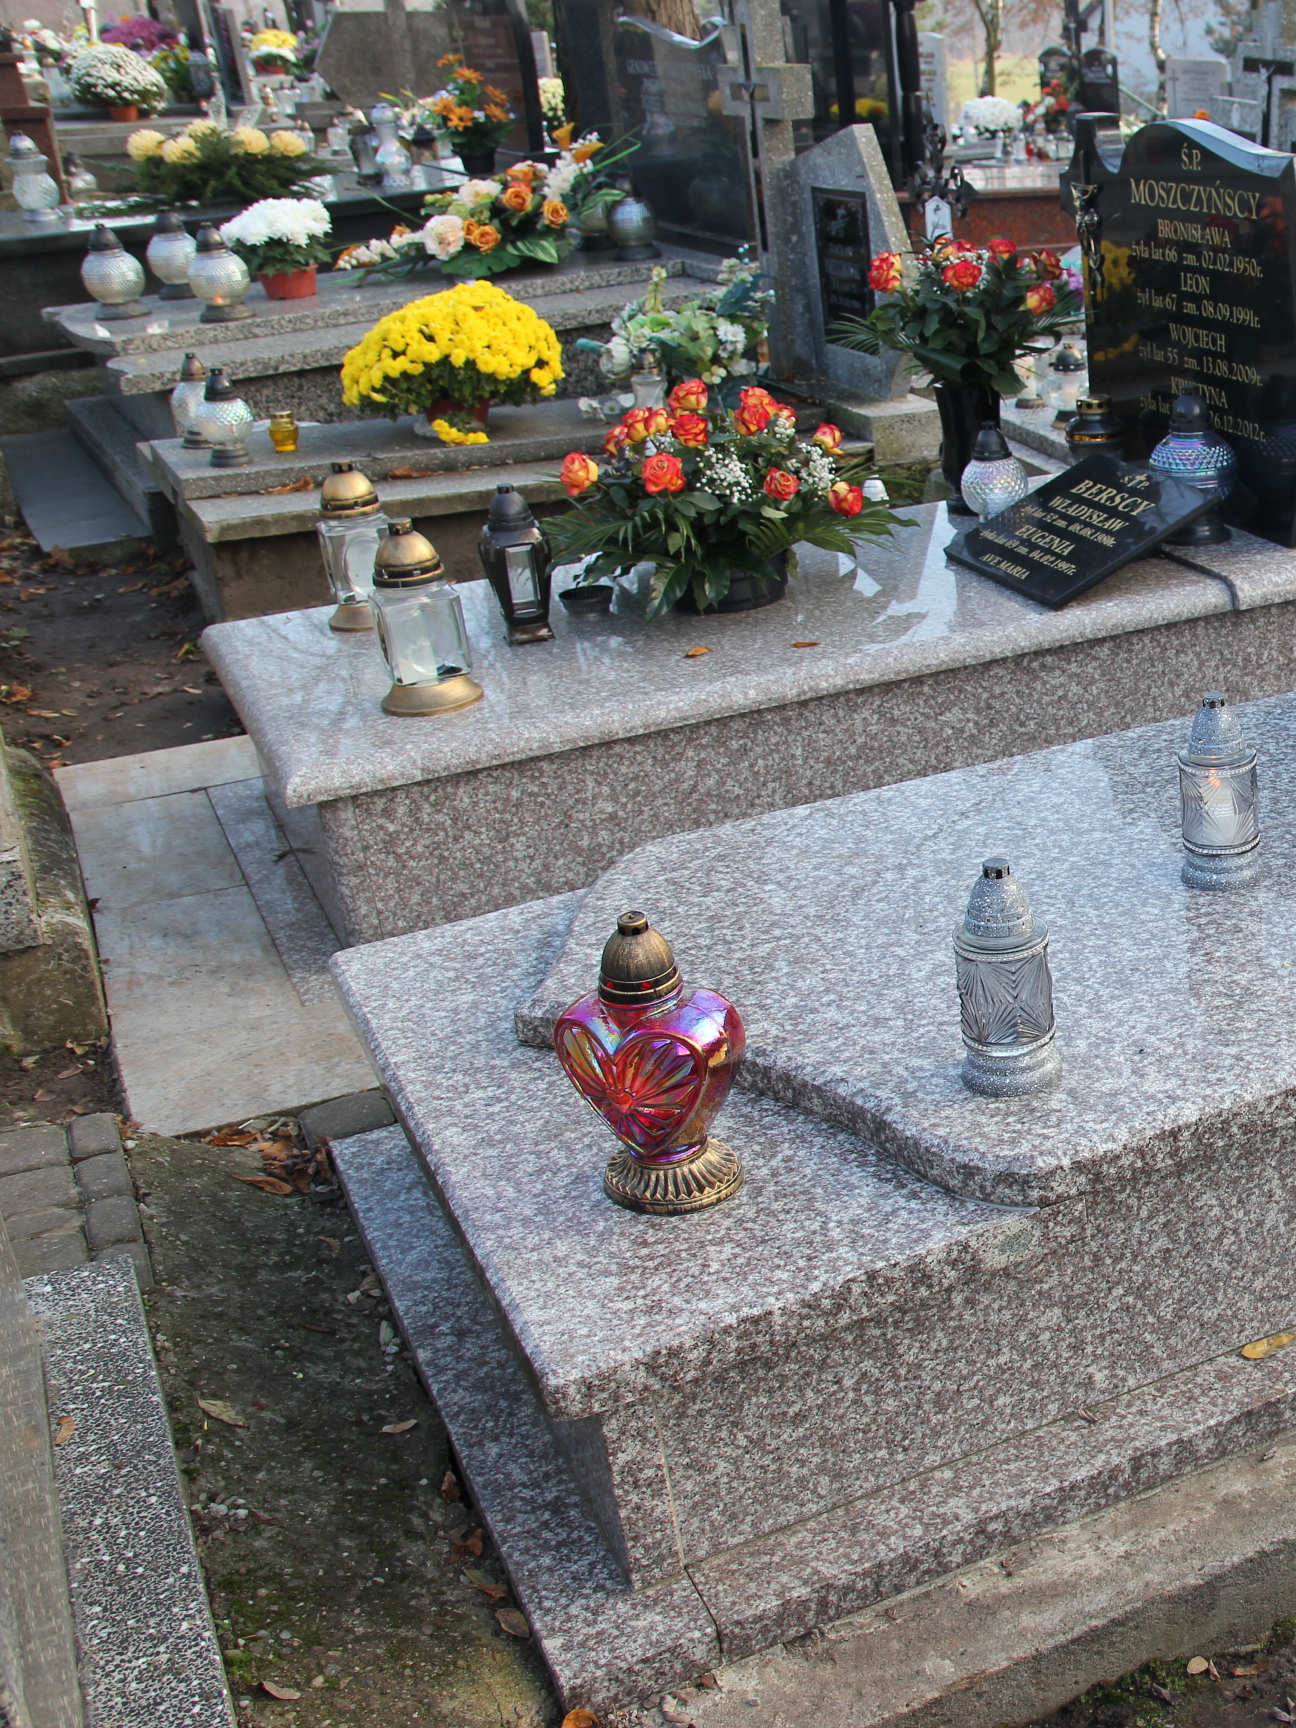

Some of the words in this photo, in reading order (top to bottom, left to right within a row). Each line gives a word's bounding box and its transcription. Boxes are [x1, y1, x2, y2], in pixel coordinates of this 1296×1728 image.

[1129, 178, 1261, 219] MOSZCZYŃSCY
[1157, 218, 1231, 248] BRONISŁAWA
[1151, 241, 1165, 260] lat
[1165, 245, 1178, 262] 66
[1182, 253, 1200, 267] zm.
[1180, 272, 1210, 295] LEON
[1151, 289, 1165, 306] lat
[1165, 292, 1177, 311] 67
[1182, 302, 1200, 316] zm.
[1169, 322, 1226, 353] WOJCIECH
[1167, 349, 1179, 366] 55
[1183, 356, 1201, 370] zm.
[1171, 376, 1228, 409] KRTYNA
[1070, 479, 1156, 516] BERSCY
[1048, 496, 1130, 532] WŁADYSŁAW
[1014, 524, 1076, 556] EUGENIA
[979, 553, 1002, 566] AVE
[997, 560, 1030, 580] MARIA
